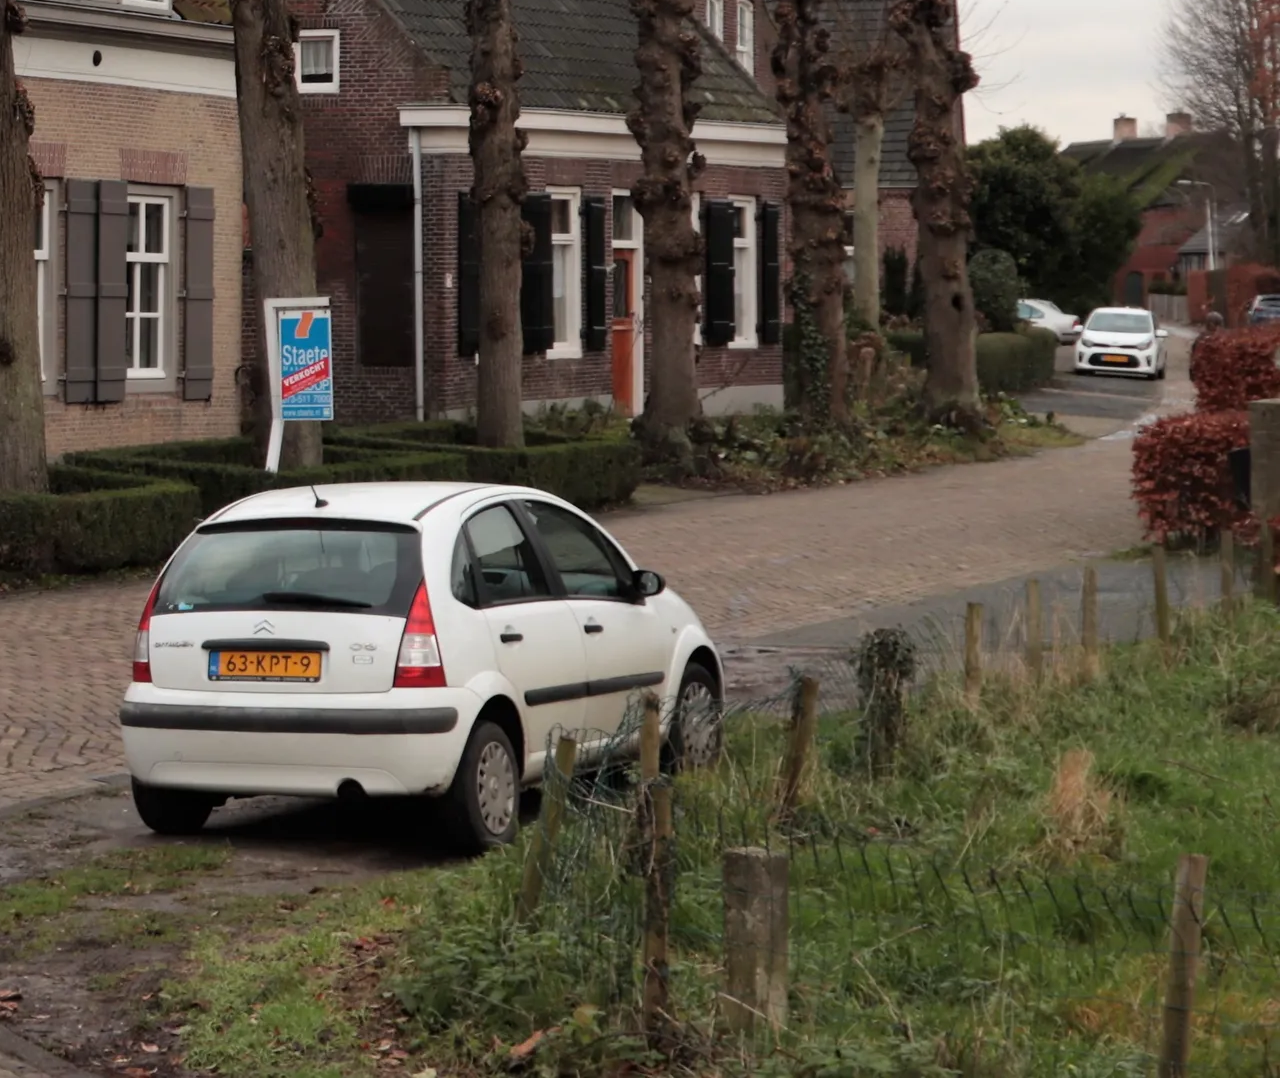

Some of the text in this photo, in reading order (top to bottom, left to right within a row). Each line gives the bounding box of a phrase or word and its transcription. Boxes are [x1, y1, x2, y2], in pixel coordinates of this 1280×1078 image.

[283, 345, 328, 365] Staete
[283, 361, 325, 386] VERKOCHT
[226, 654, 311, 673] 63-KPT-9
